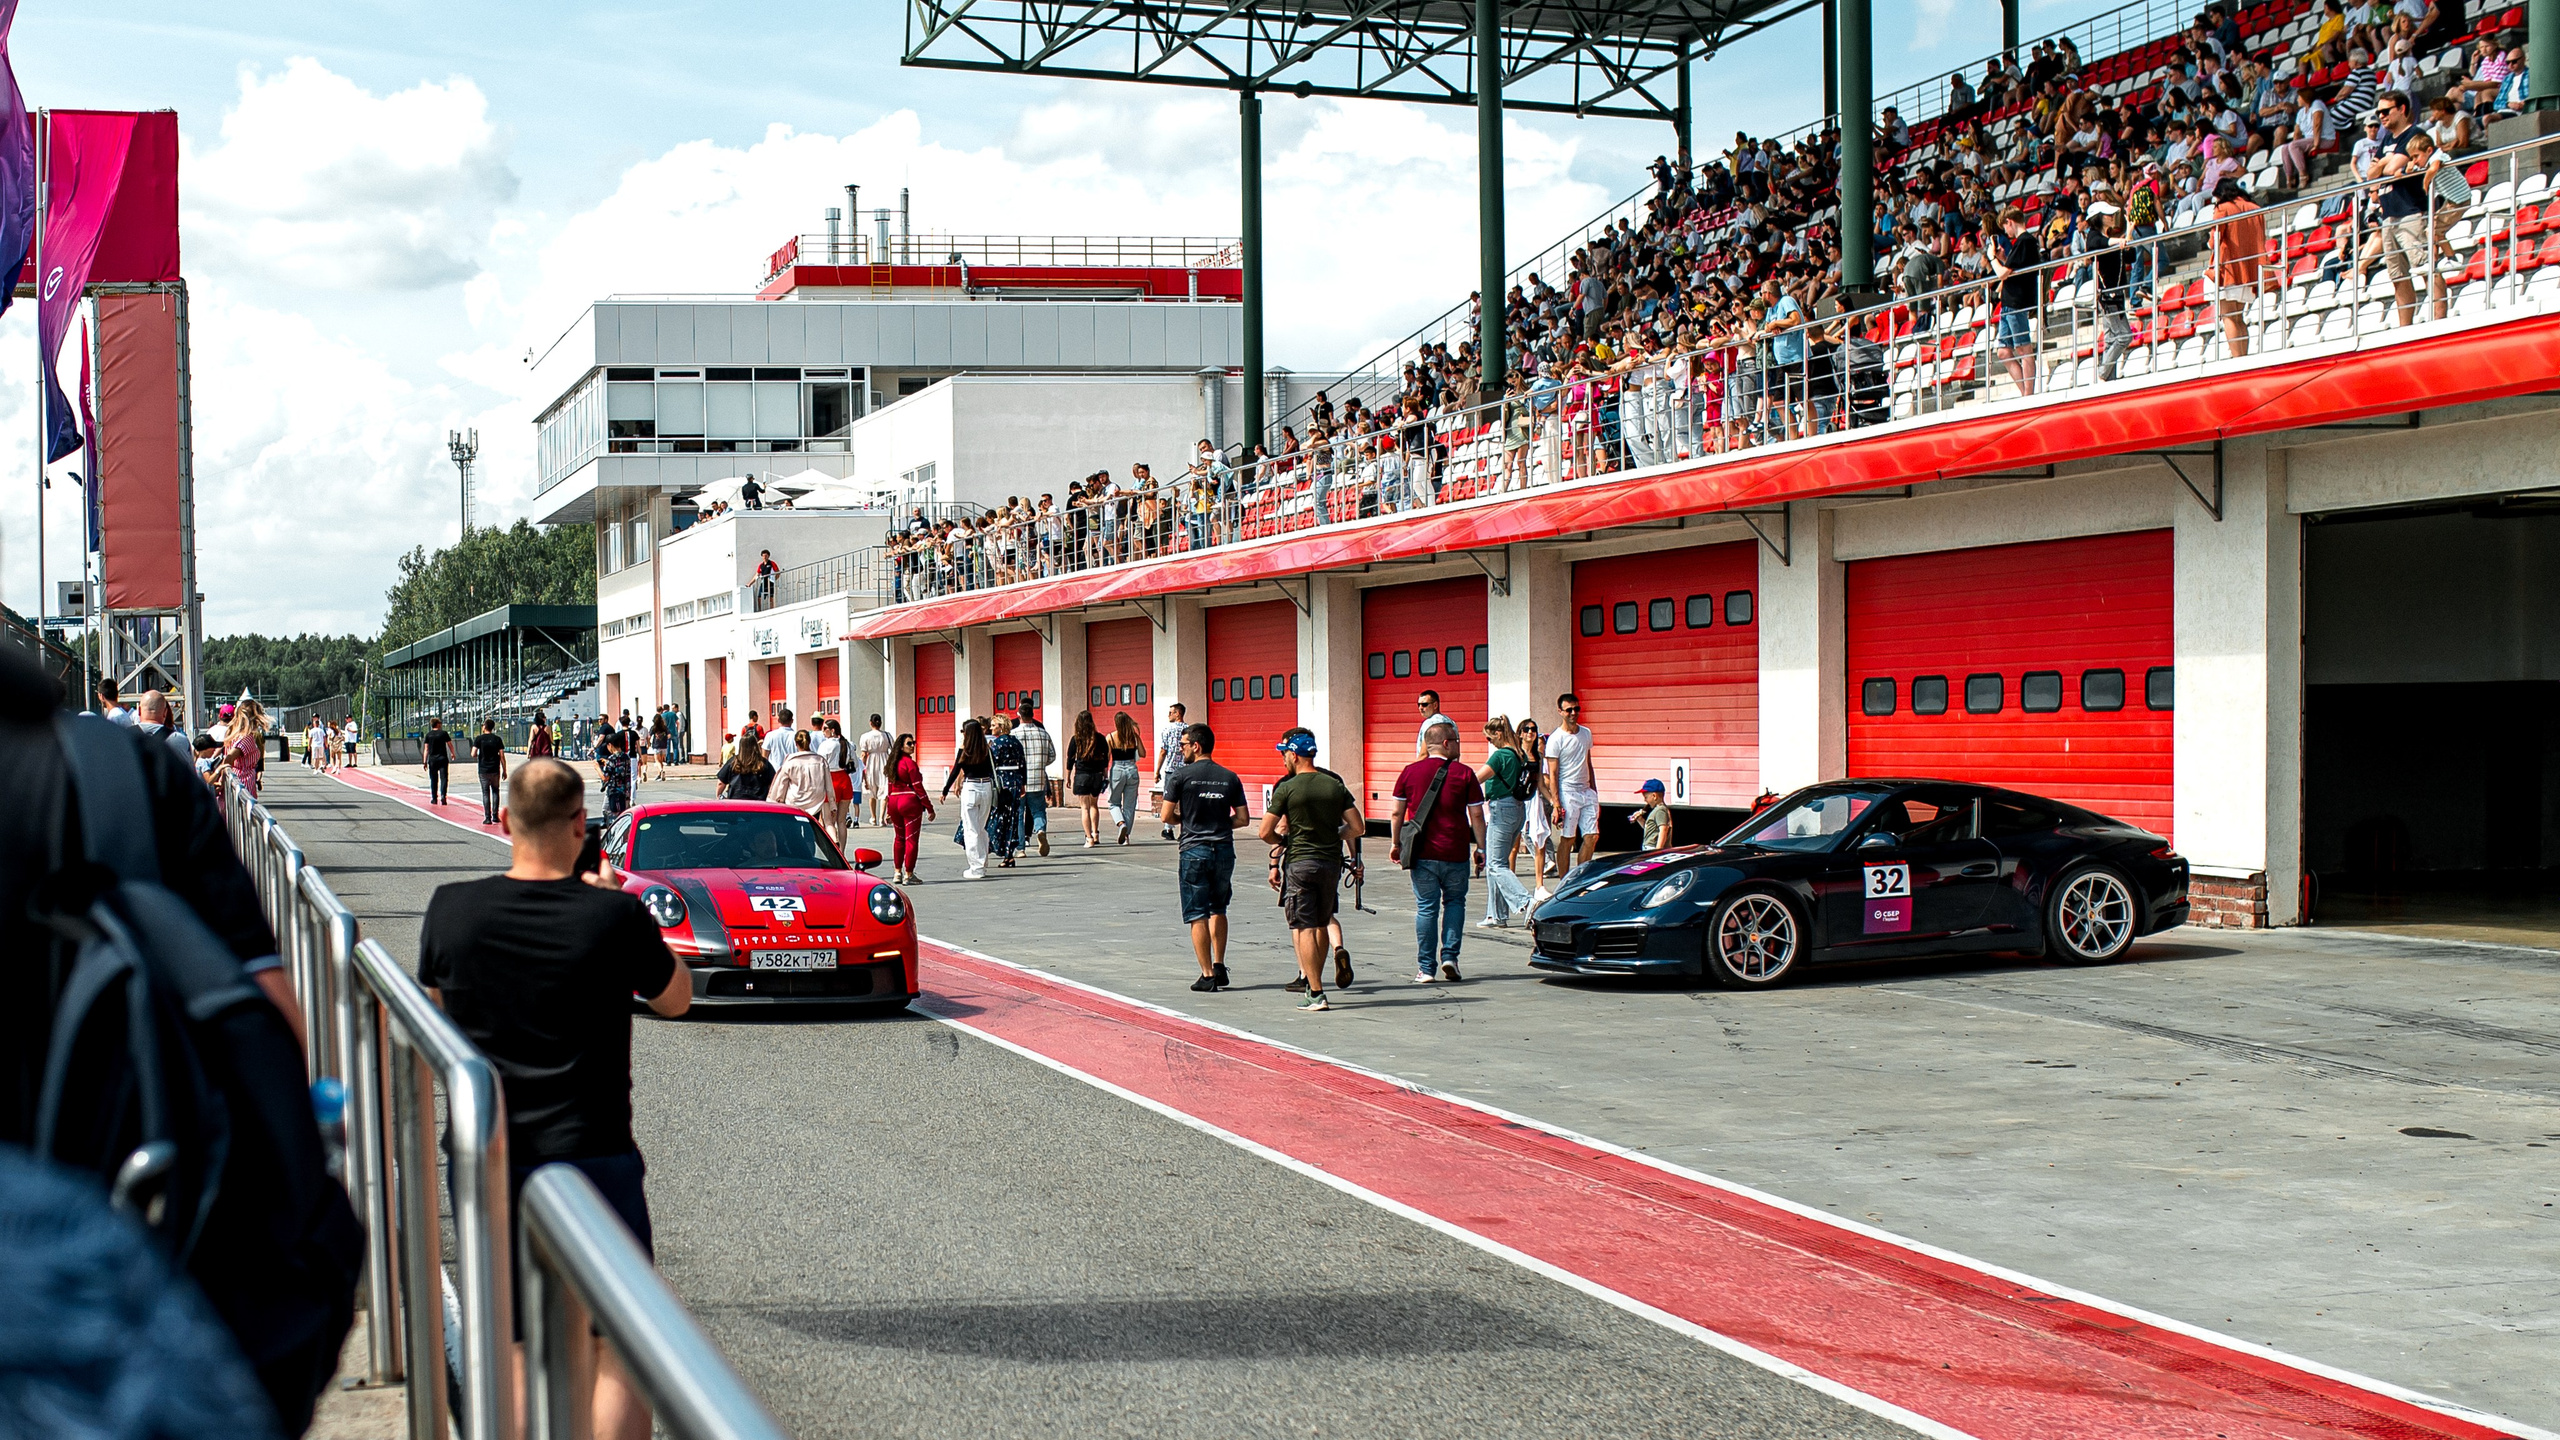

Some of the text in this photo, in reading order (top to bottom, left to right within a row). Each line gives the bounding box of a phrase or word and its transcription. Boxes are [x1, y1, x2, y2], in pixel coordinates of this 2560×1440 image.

[1677, 766, 1684, 799] 8
[1871, 867, 1904, 895] 32
[760, 898, 798, 909] 42
[812, 952, 833, 963] 797
